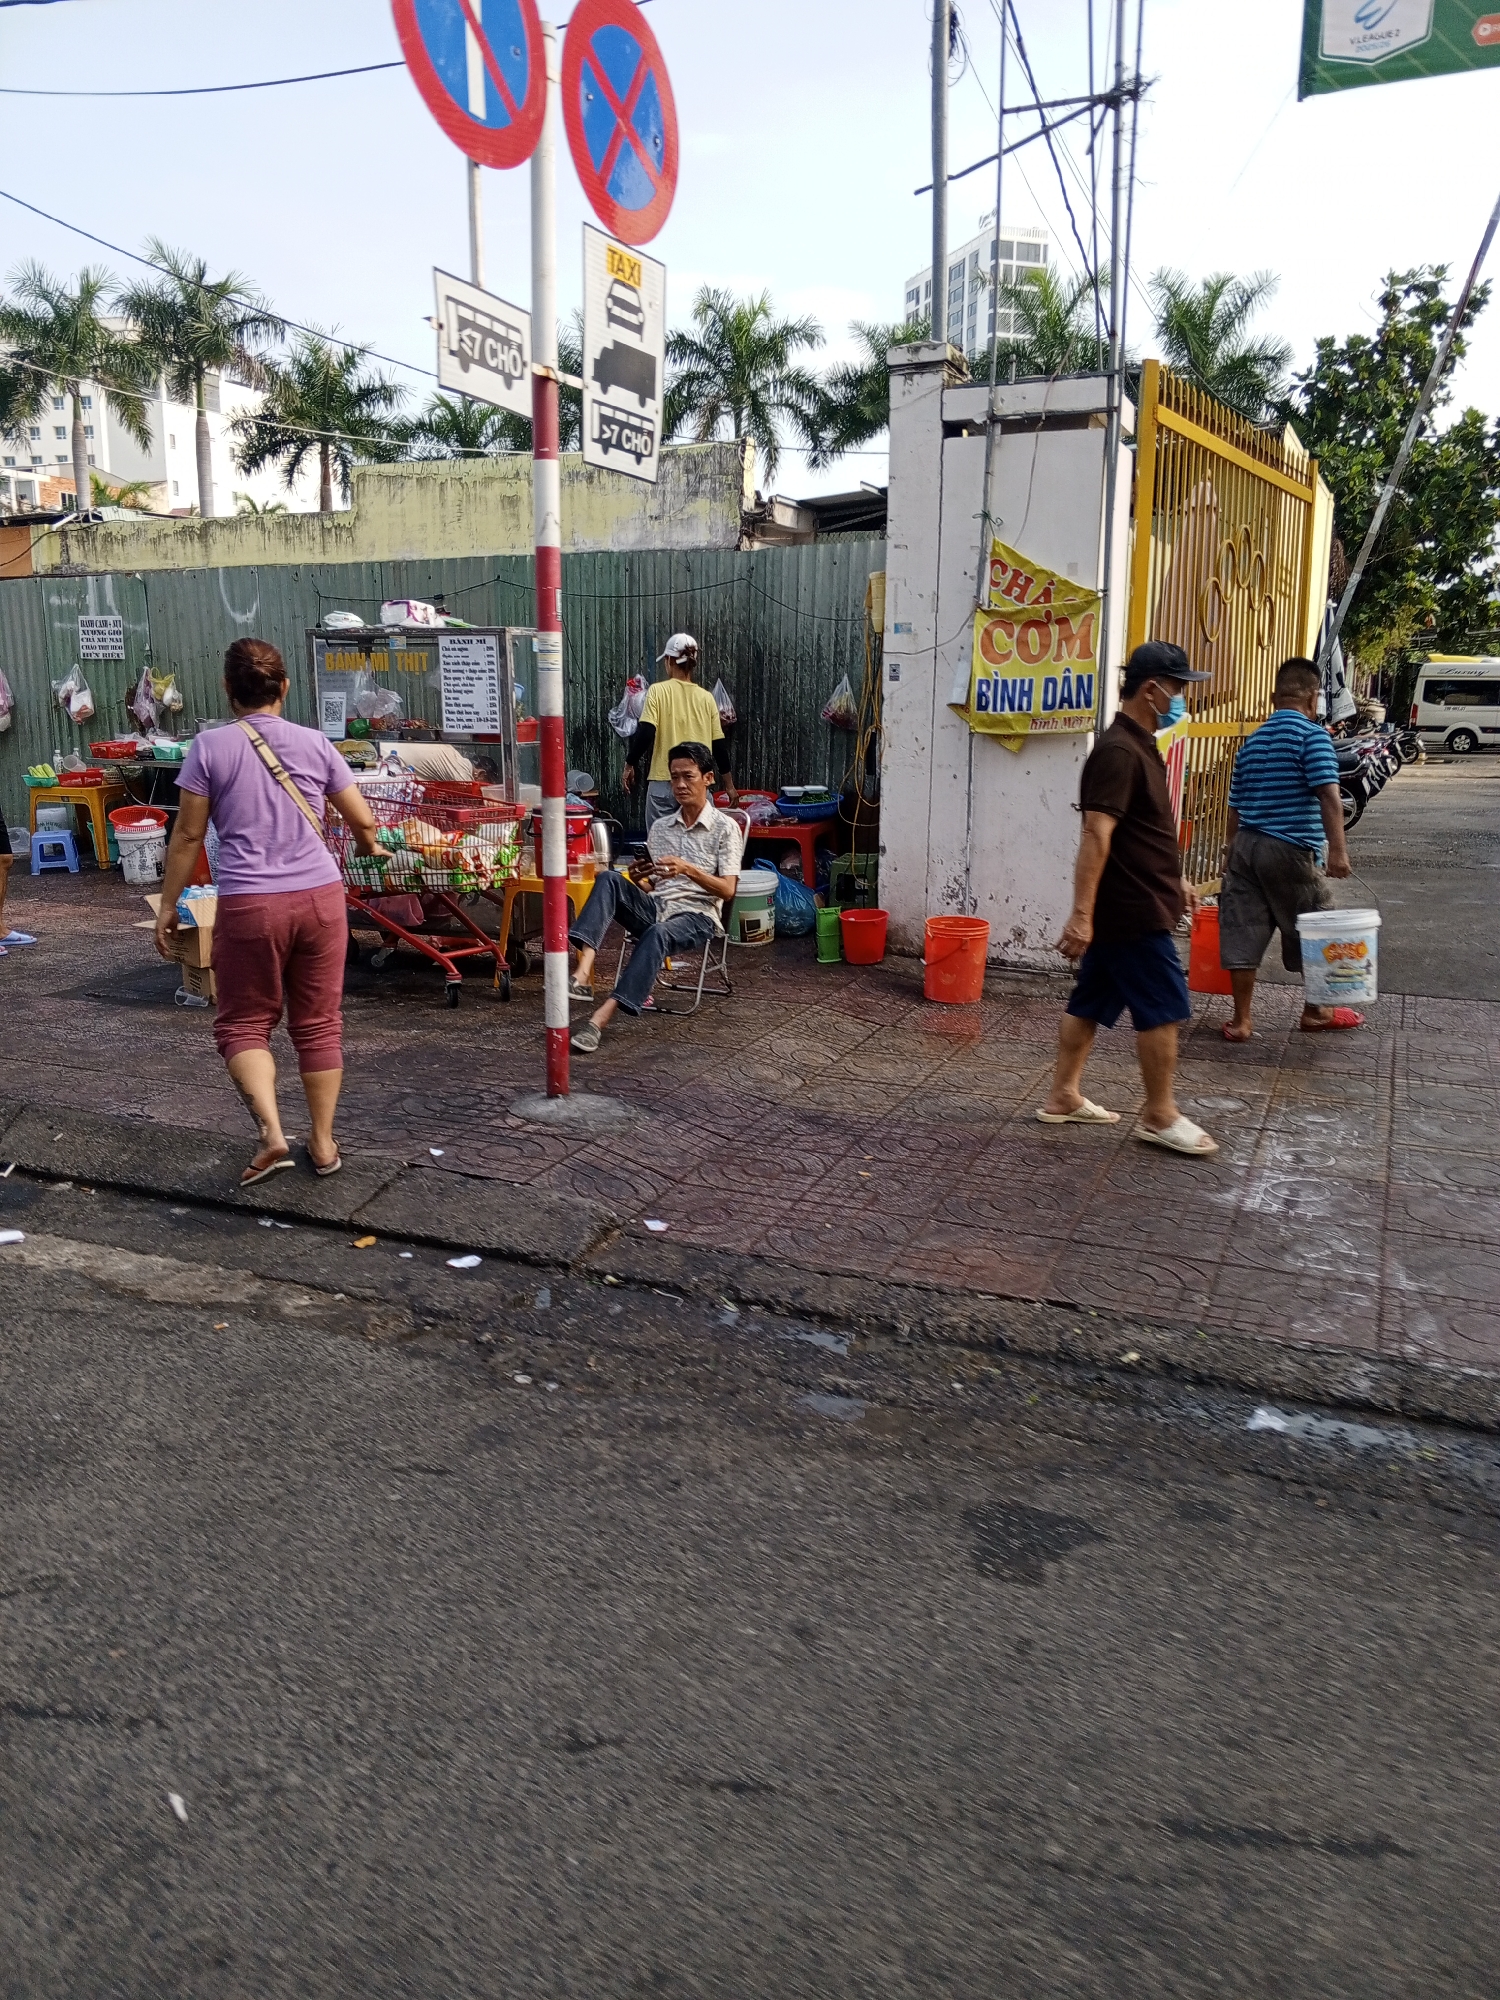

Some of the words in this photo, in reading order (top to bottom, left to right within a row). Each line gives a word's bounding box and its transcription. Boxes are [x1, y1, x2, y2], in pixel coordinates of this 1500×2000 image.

[608, 250, 641, 288] TAXI
[484, 338, 523, 378] CHỖ
[621, 429, 651, 456] CHỖ
[979, 609, 1094, 666] CƠM
[325, 647, 366, 672] BÁNH
[370, 647, 389, 672] MÌ
[395, 652, 428, 675] THỊT
[976, 670, 1034, 714] BÌNH
[1041, 667, 1093, 712] DÂN
